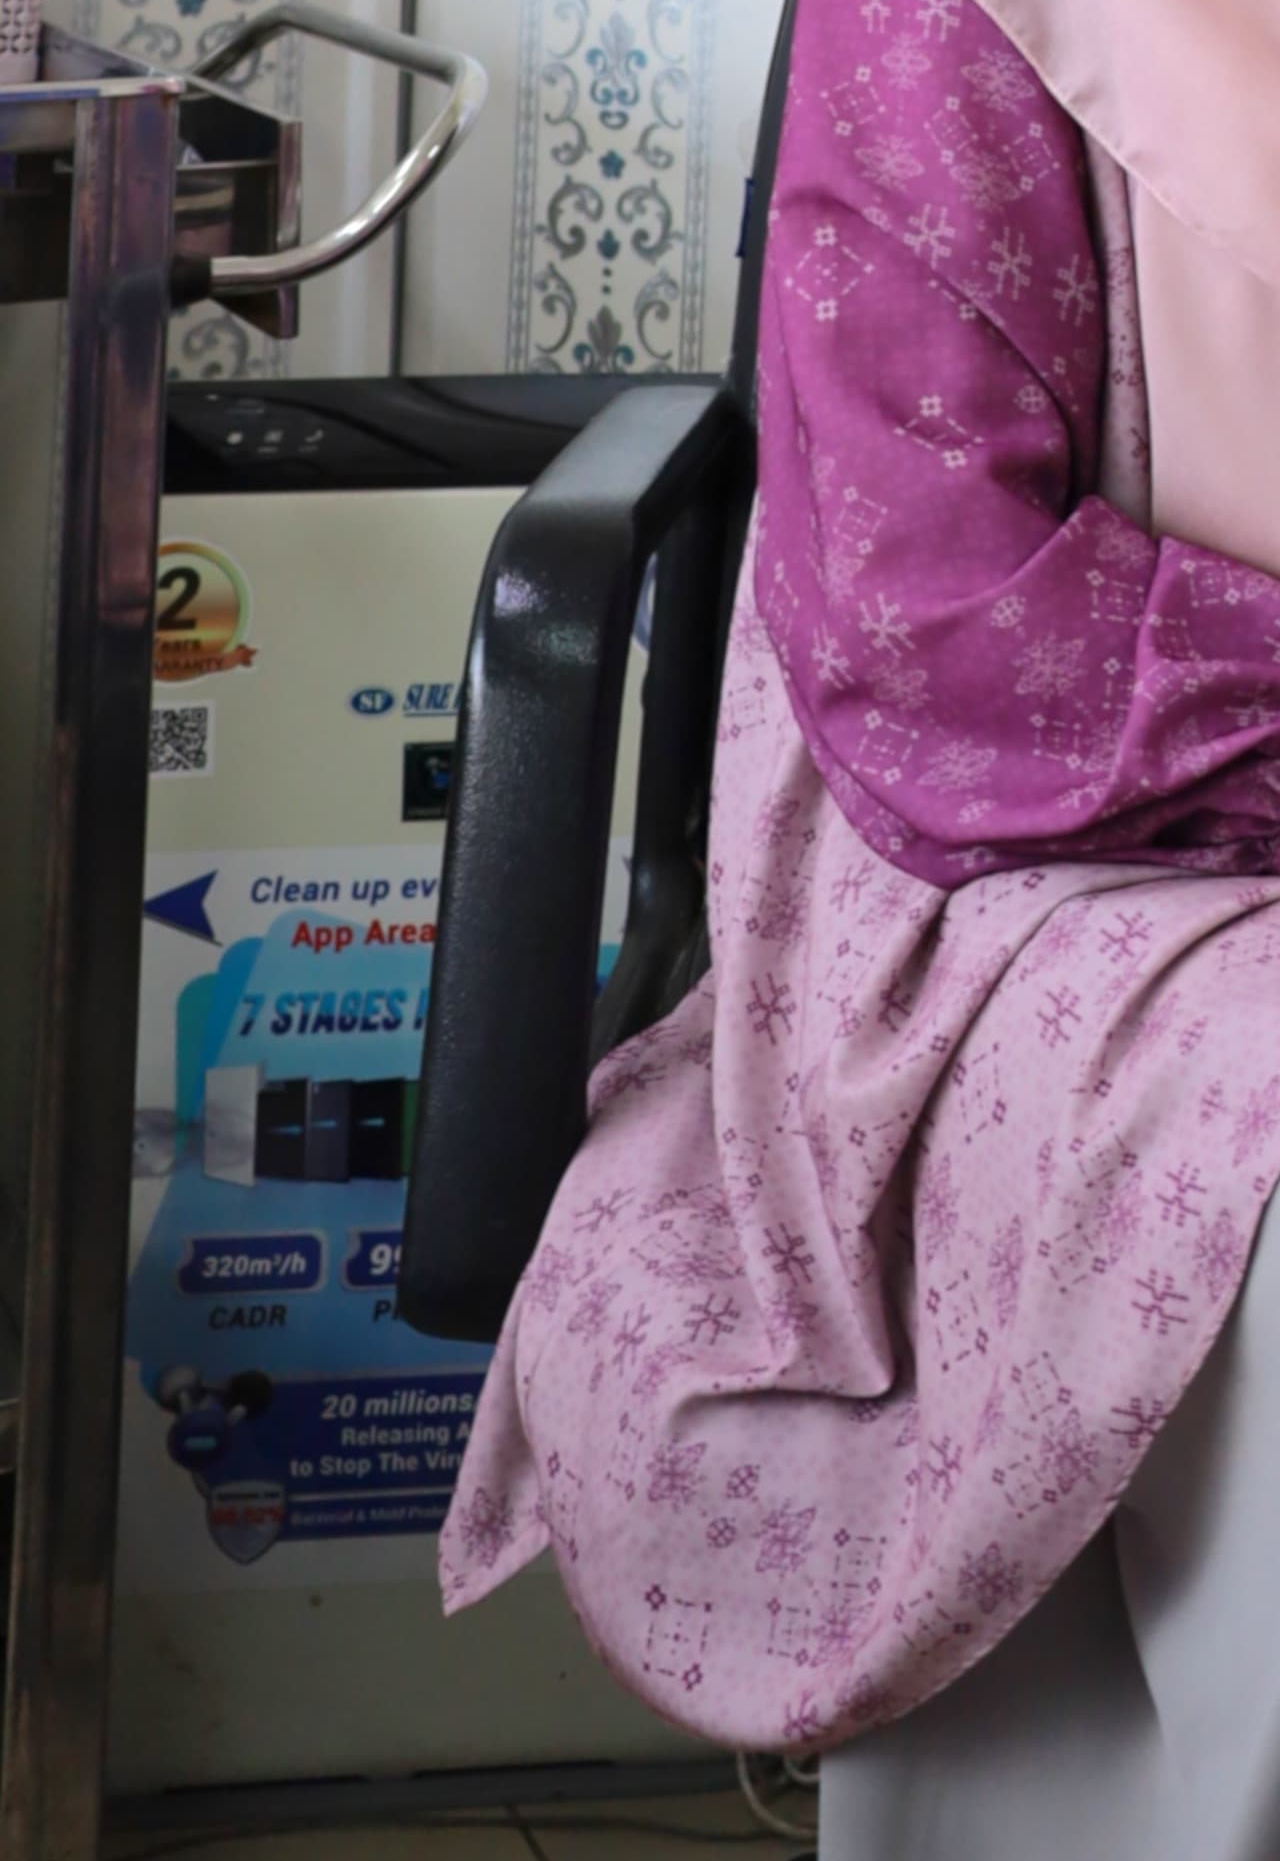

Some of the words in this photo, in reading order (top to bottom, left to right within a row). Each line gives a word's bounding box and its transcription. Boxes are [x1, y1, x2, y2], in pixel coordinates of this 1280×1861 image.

[157, 566, 201, 631] 2
[251, 876, 340, 903] Clean
[352, 878, 390, 907] up
[401, 878, 438, 898] ev
[291, 919, 354, 954] App
[364, 918, 438, 945] Area
[240, 995, 264, 1036] 7
[270, 988, 407, 1035] STAGES
[208, 1304, 288, 1330] CADR
[321, 1394, 357, 1420] 20
[364, 1390, 477, 1417] millions
[341, 1424, 449, 1446] Releasing
[290, 1458, 313, 1477] to
[319, 1455, 372, 1478] Stop
[378, 1451, 419, 1471] The
[425, 1450, 462, 1470] Viru
